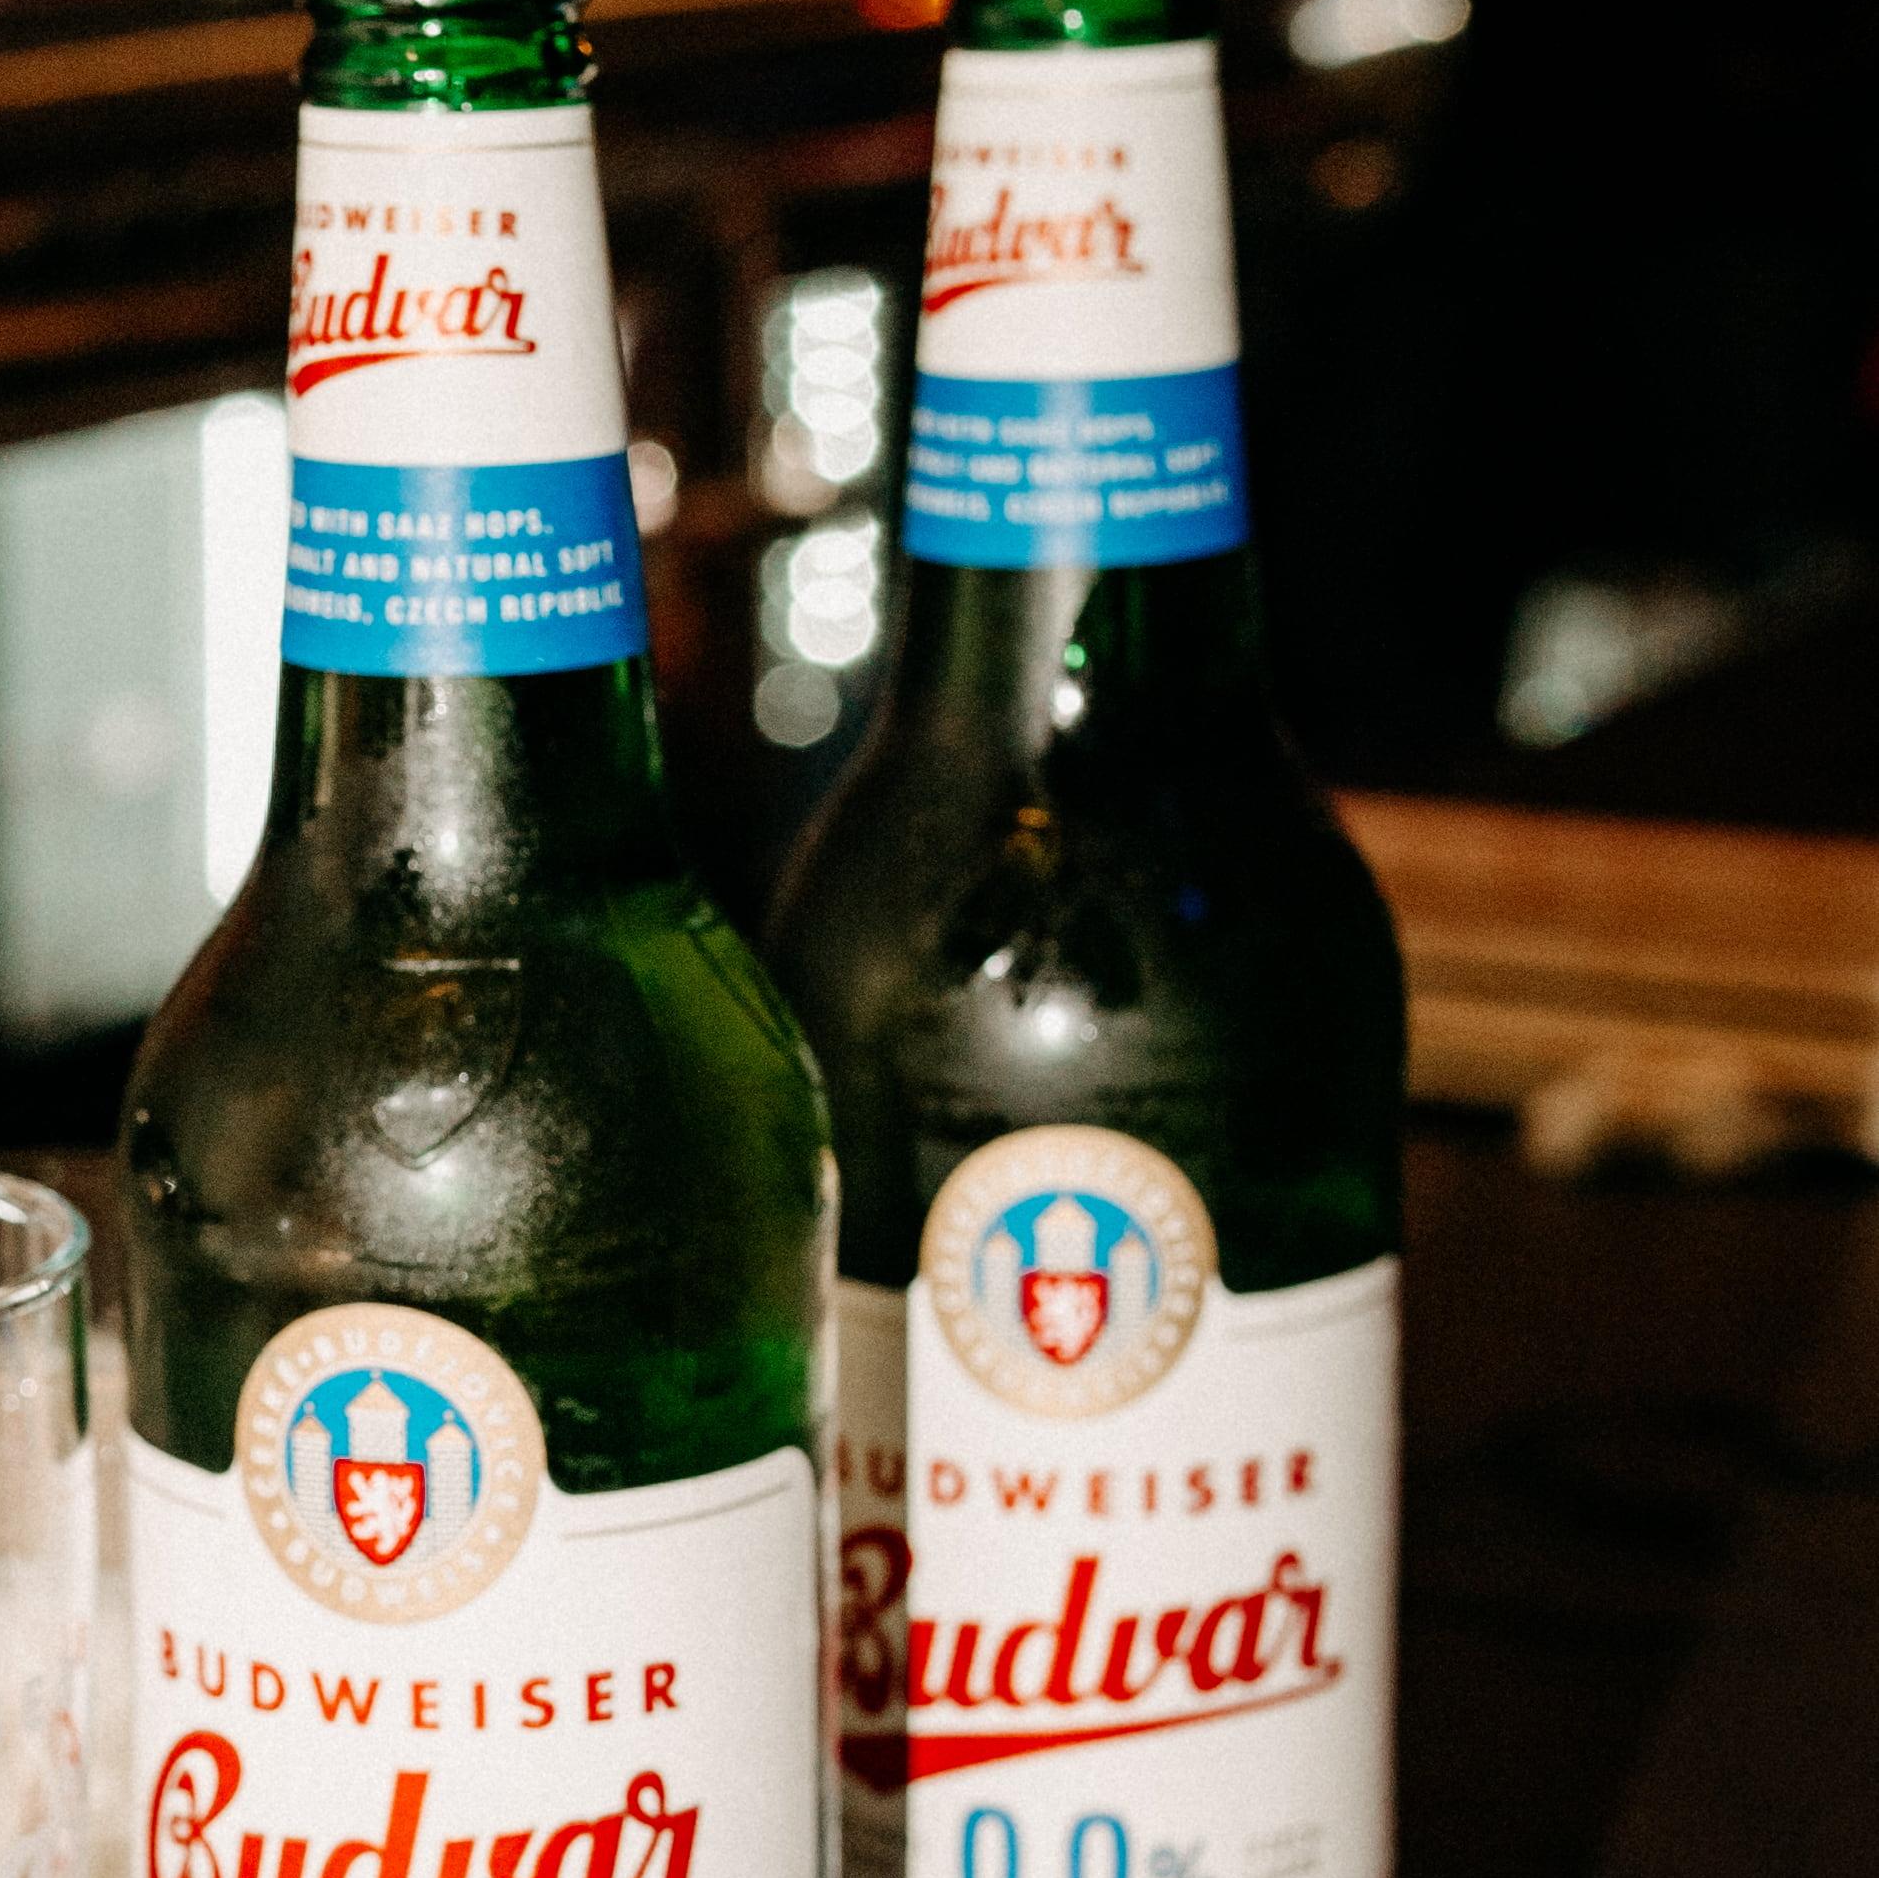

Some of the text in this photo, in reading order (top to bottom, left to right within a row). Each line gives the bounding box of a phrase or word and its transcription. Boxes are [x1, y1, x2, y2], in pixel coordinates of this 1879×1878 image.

[410, 551, 547, 582] NATURAL
[384, 594, 487, 625] CZECH
[161, 1628, 678, 1730] BUDWEISER
